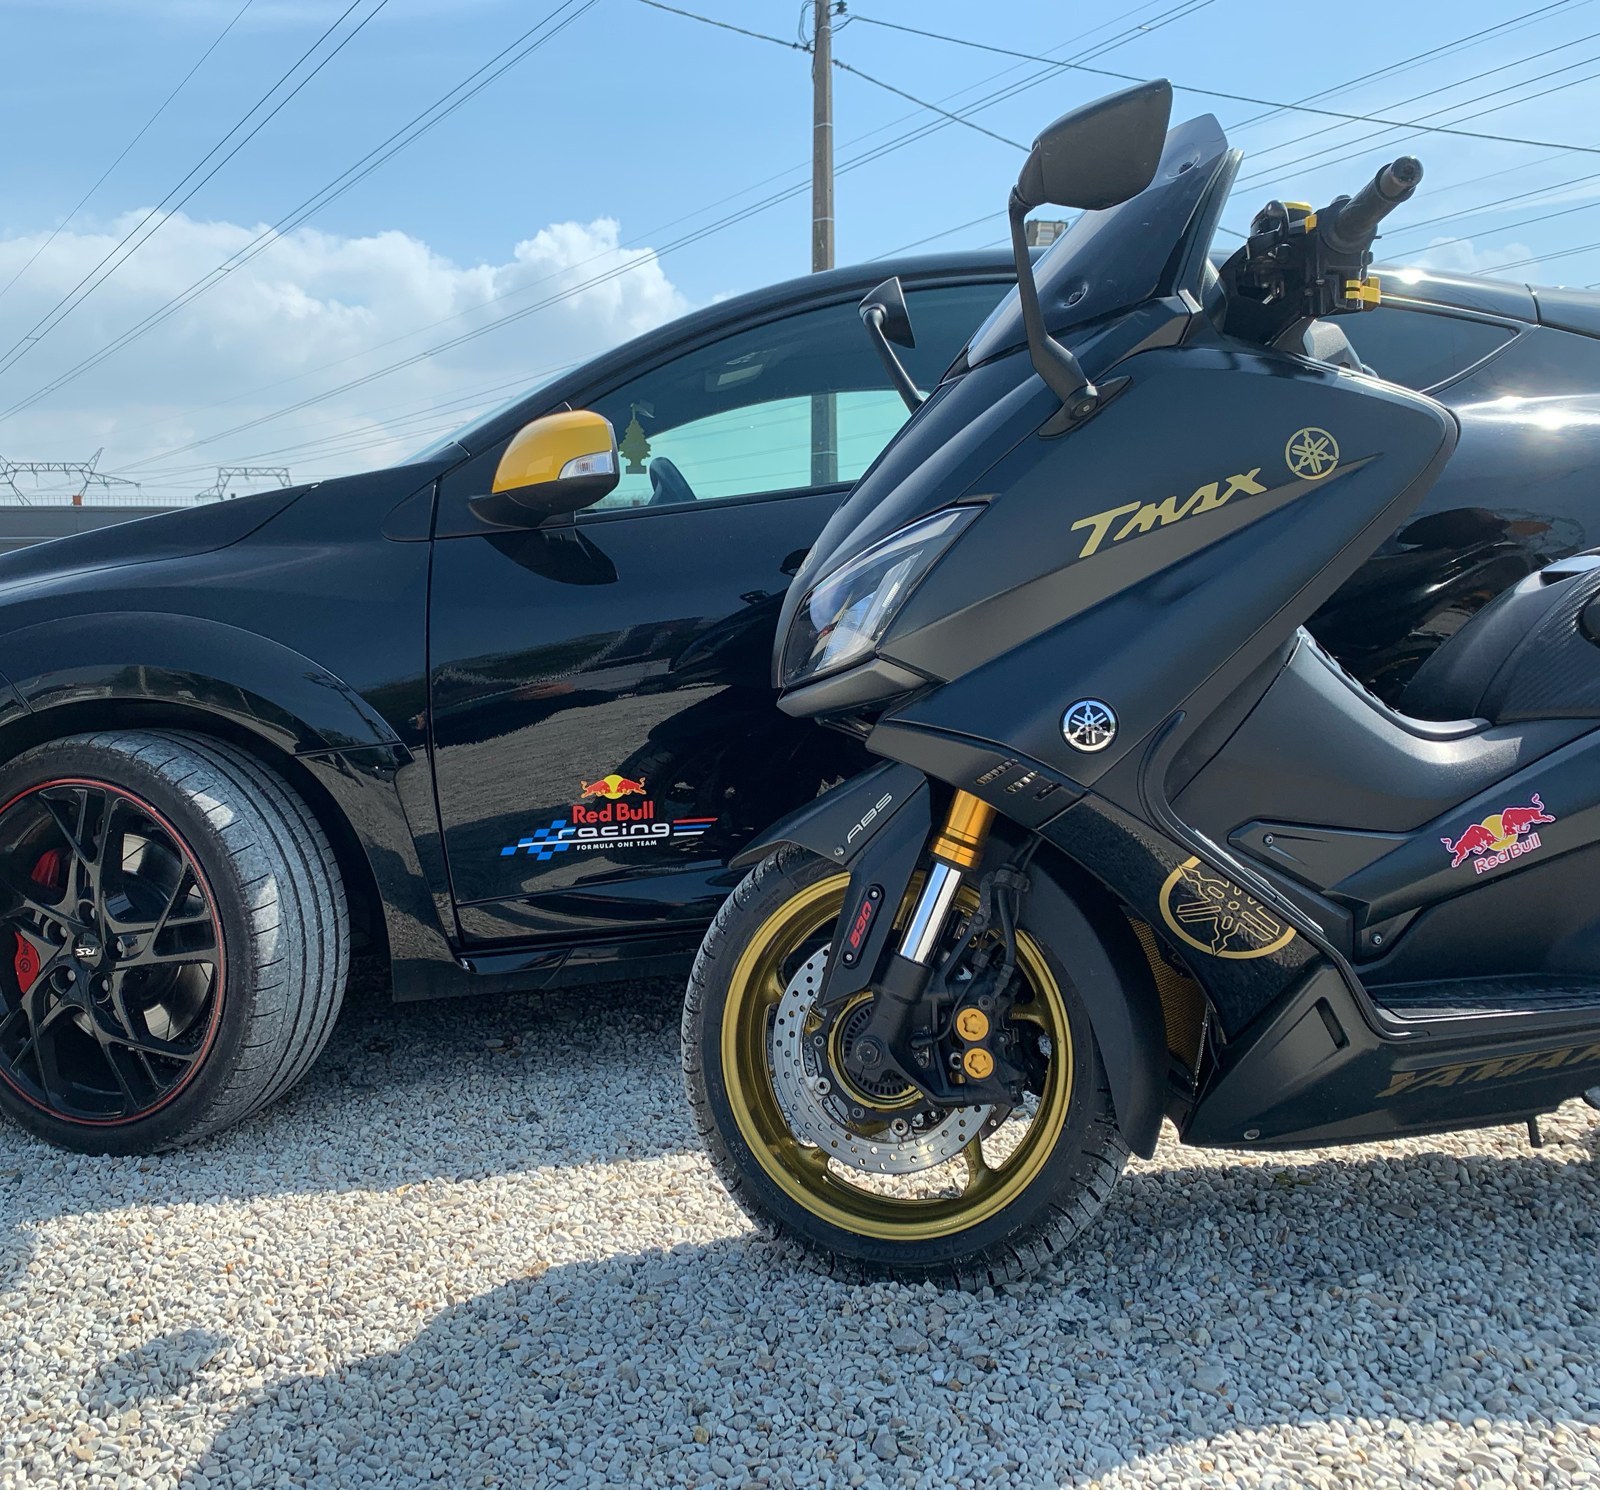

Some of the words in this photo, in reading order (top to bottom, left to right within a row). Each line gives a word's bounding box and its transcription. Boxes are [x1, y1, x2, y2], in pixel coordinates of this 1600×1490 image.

[1071, 468, 1267, 558] TMAX
[572, 804, 611, 824] Red
[616, 801, 654, 821] Bull
[847, 793, 892, 843] ABS
[558, 823, 670, 839] racing
[576, 842, 614, 851] FORMULA
[617, 840, 634, 848] ONE
[636, 839, 657, 847] TEAM
[1474, 849, 1509, 873] Red
[1510, 832, 1541, 858] Bull
